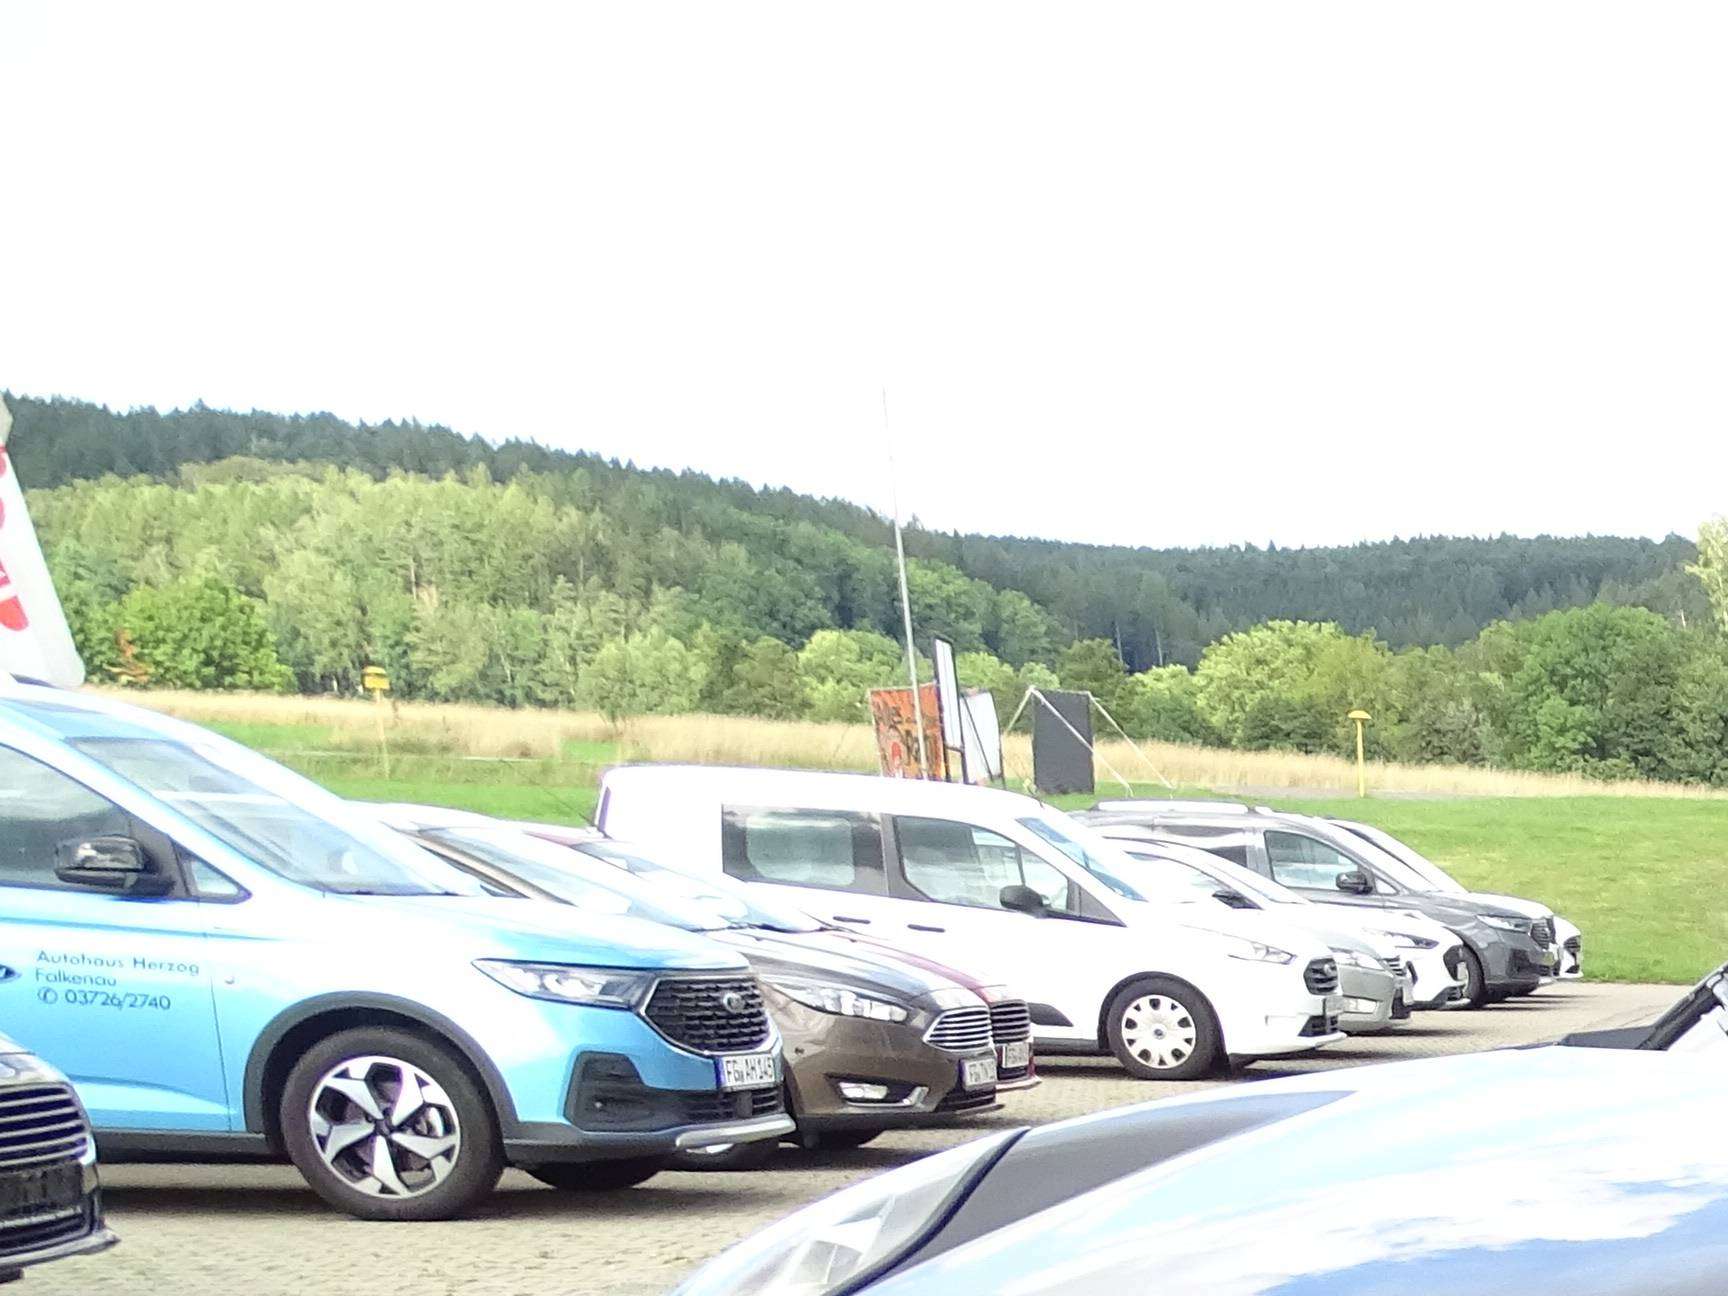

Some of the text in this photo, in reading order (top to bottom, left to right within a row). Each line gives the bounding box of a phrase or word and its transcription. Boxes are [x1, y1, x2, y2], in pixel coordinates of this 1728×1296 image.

[37, 950, 200, 976] Autohaus Herzog
[35, 968, 117, 986] Falkenau
[64, 988, 171, 1010] 03726/2740
